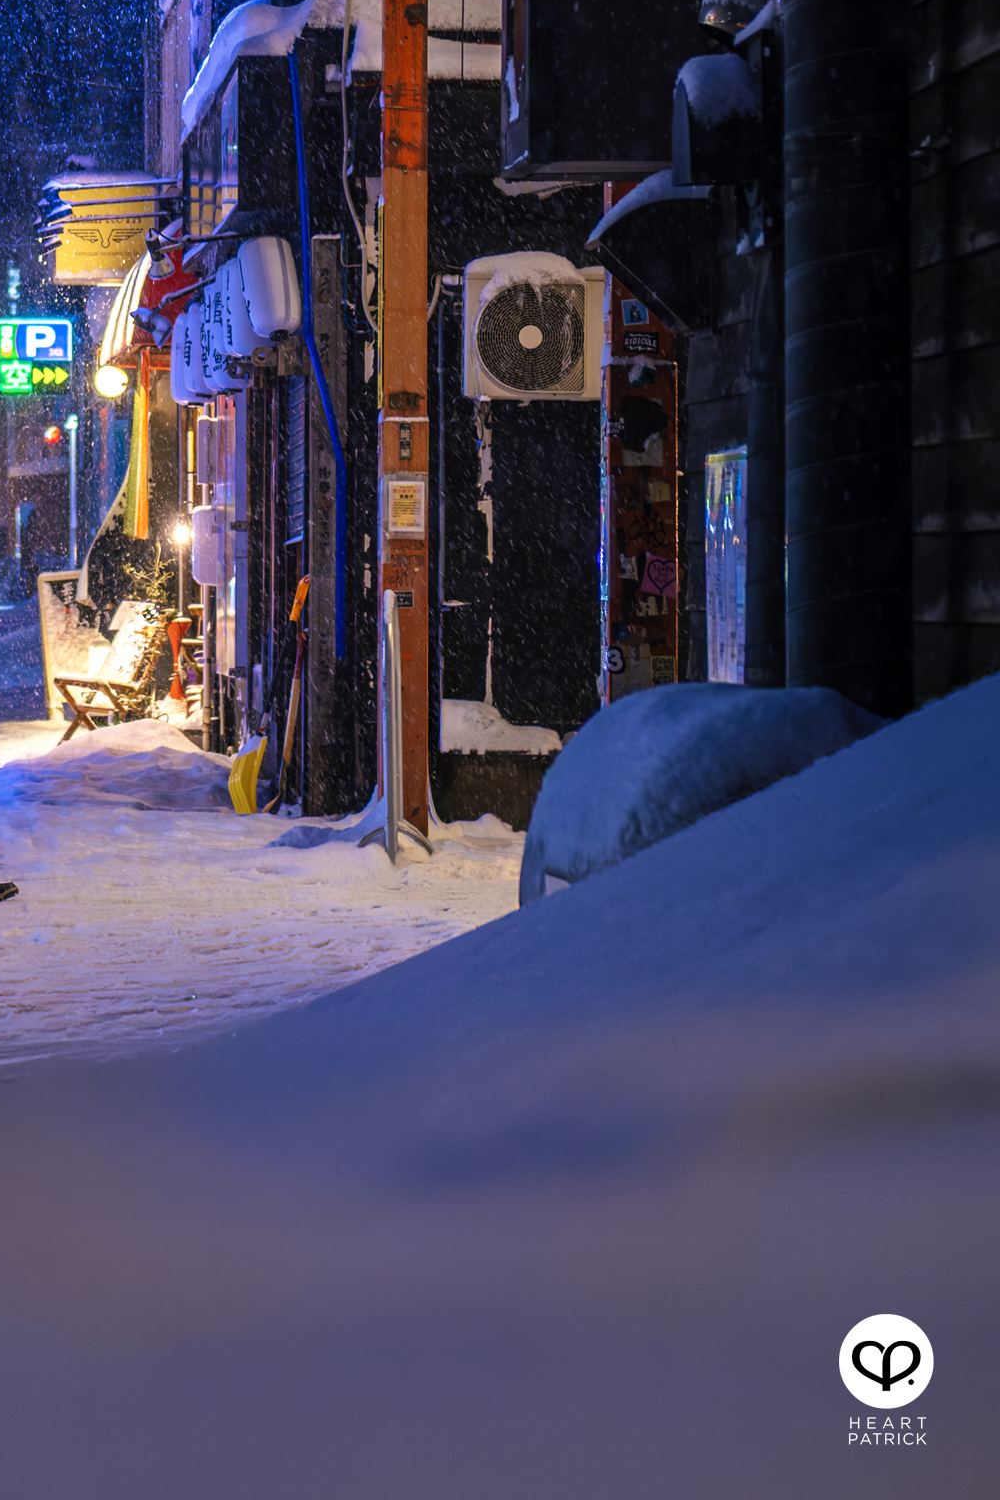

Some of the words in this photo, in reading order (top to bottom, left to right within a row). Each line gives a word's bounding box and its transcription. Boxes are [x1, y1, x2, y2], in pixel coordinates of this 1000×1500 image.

[26, 326, 56, 357] P
[624, 337, 657, 348] RIDICULE
[1, 360, 31, 390] 空
